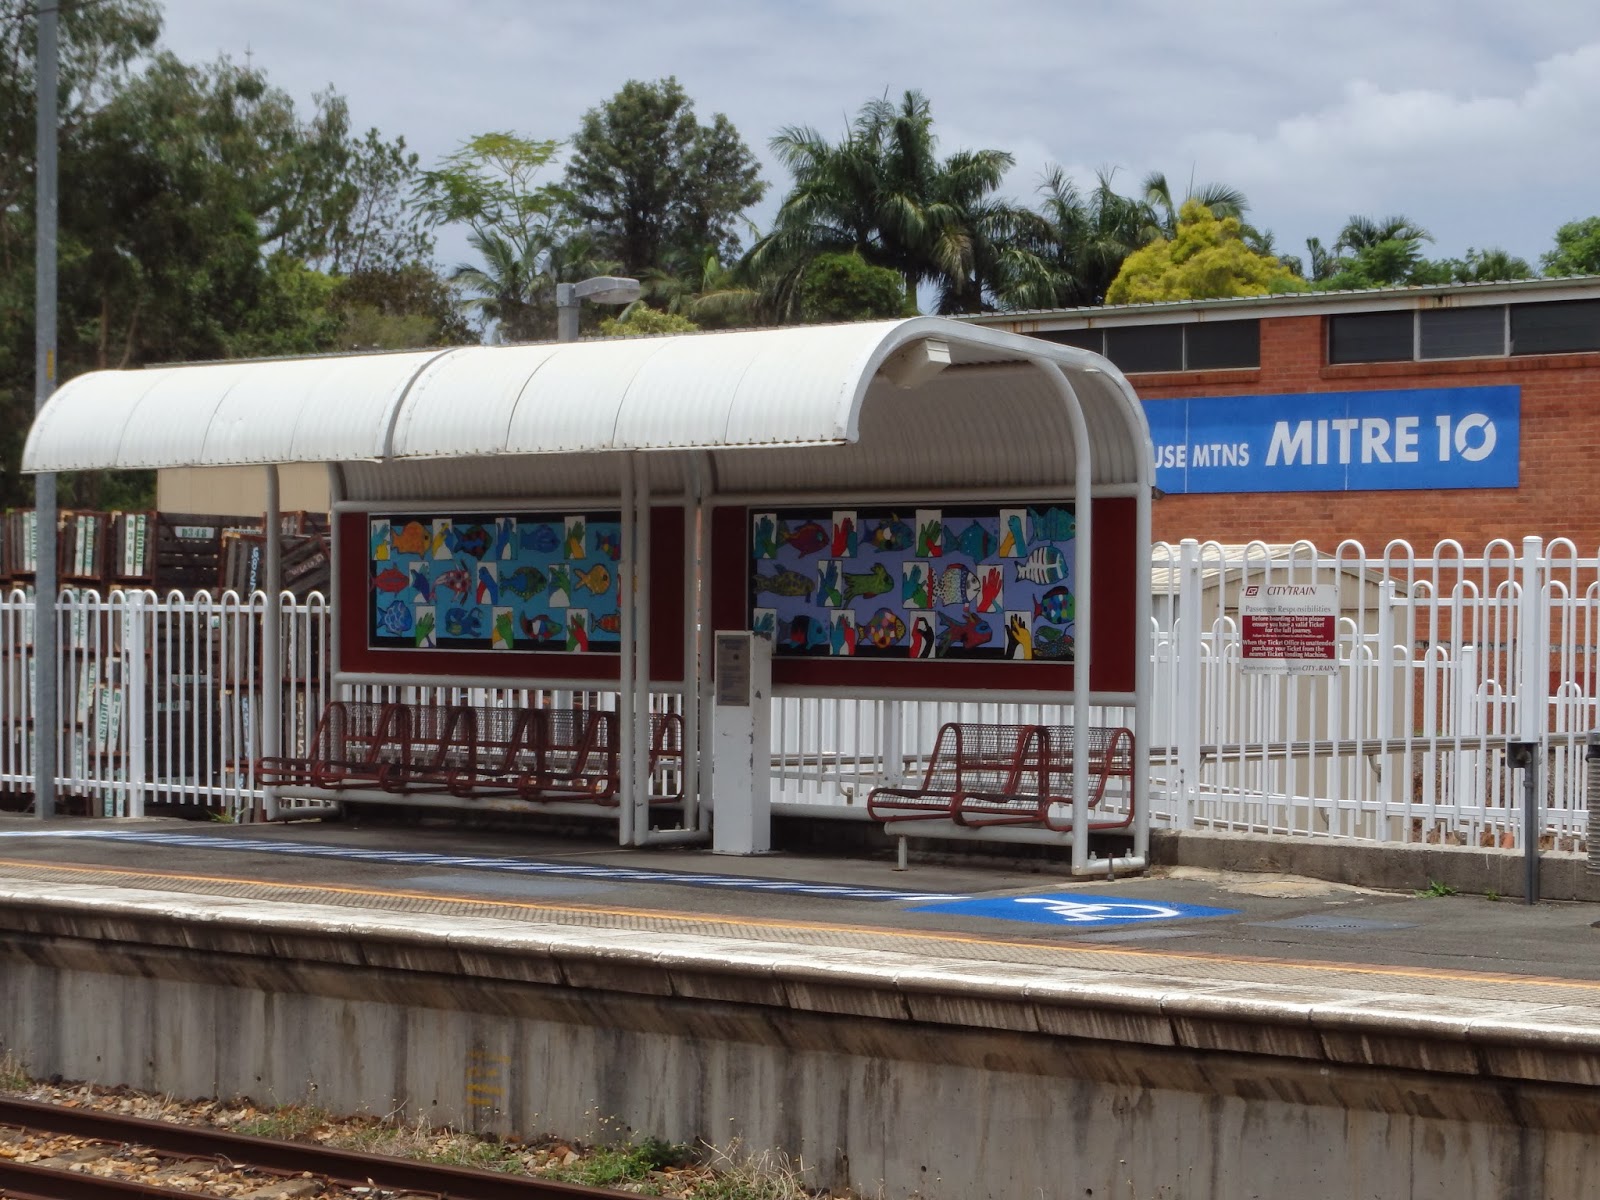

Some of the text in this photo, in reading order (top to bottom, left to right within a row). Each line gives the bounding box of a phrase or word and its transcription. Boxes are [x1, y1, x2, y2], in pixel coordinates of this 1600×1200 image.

[1192, 443, 1249, 467] MTNS
[1265, 416, 1419, 467] MITRE
[1436, 413, 1497, 462] 10
[181, 528, 207, 538] D348
[1266, 586, 1317, 596] CITYTRAIN
[1245, 605, 1331, 614] Passenger Responsibilities
